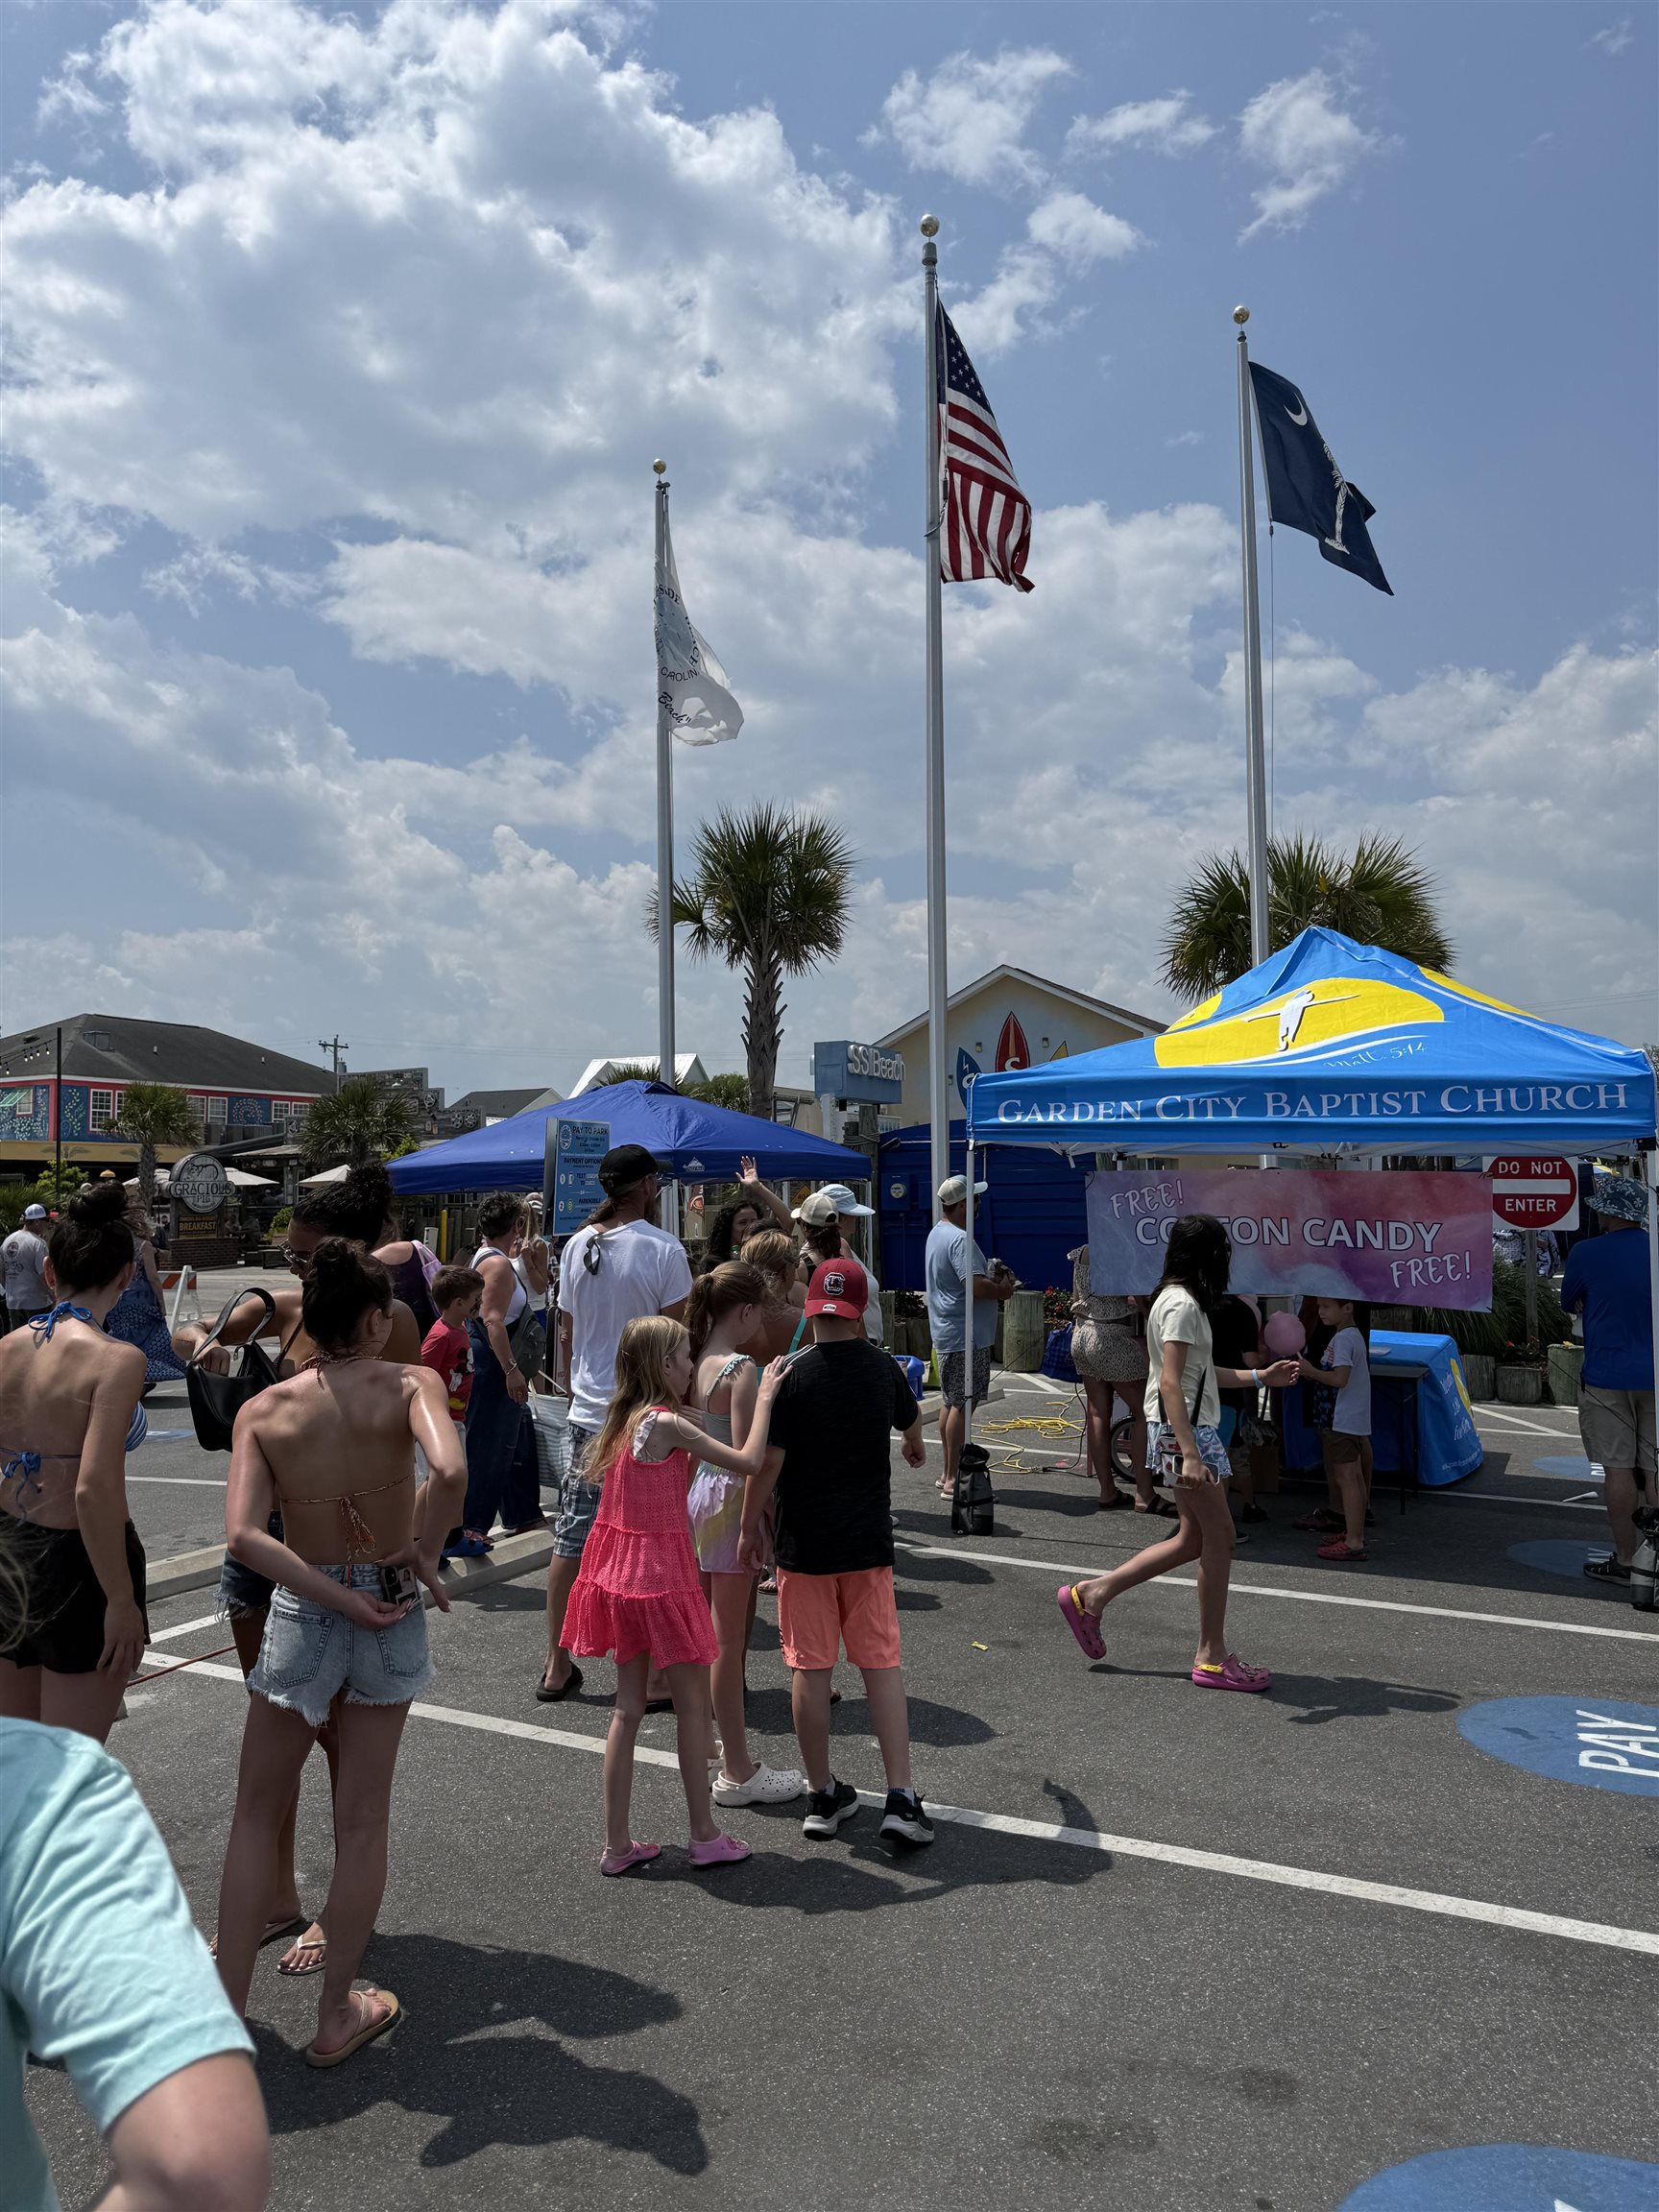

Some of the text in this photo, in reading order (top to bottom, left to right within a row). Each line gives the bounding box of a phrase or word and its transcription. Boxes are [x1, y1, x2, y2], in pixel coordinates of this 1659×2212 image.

[1390, 1042, 1428, 1059] 5:14
[998, 1082, 1629, 1123] GARDEN CITY BAPTIST CHURCH
[572, 1125, 584, 1134] PAY
[584, 1126, 592, 1135] TO
[1499, 1162, 1563, 1175] DO NOT
[174, 1182, 232, 1196] GRACIOUS
[1110, 1178, 1184, 1219] FREE!
[1504, 1198, 1556, 1212] ENTER
[179, 1221, 216, 1232] BREAKFAST
[1301, 1217, 1443, 1253] CANDY
[1390, 1251, 1471, 1288] FREE!
[1575, 1709, 1659, 1778] PAY
